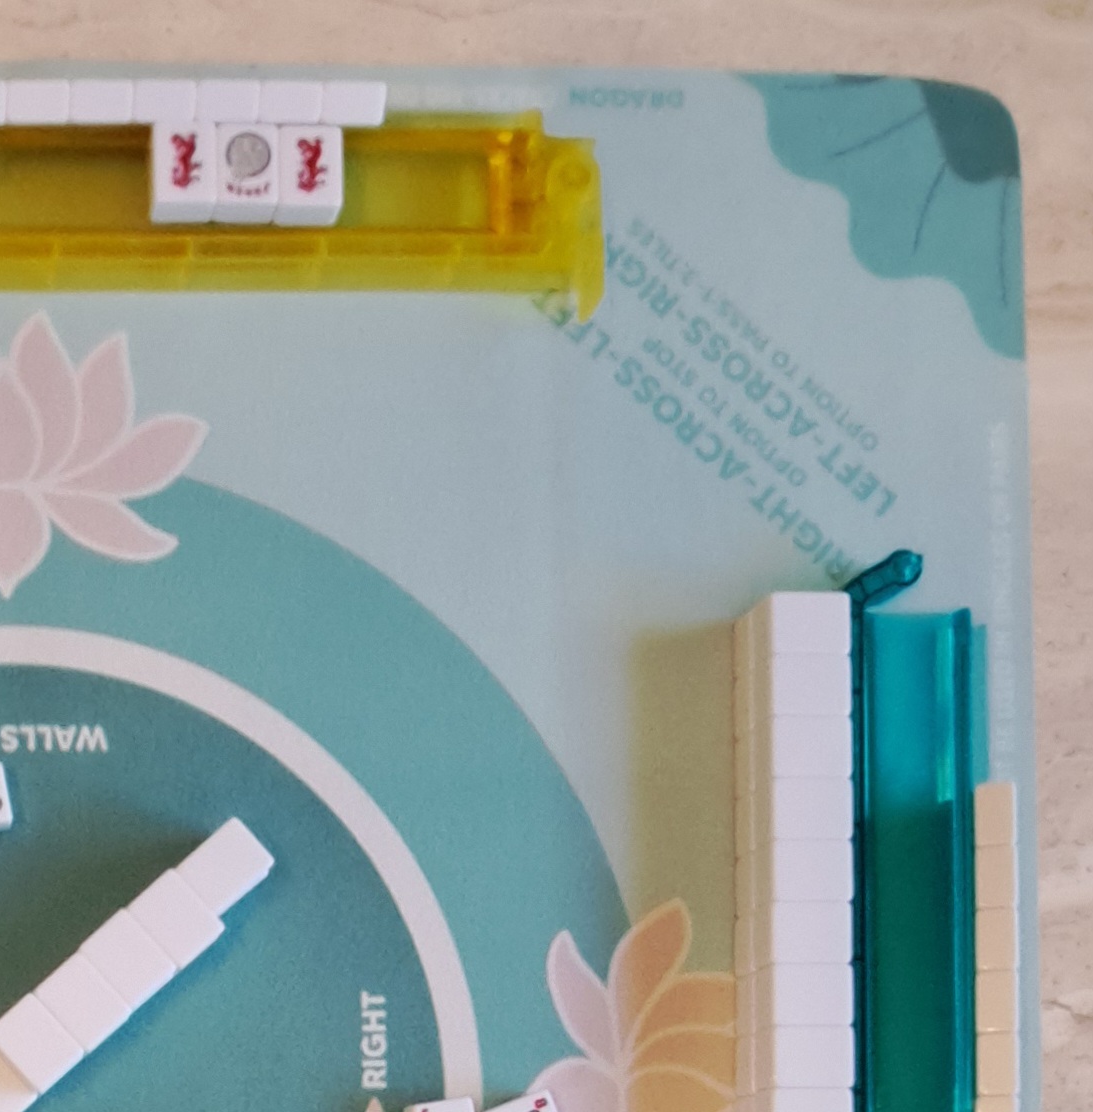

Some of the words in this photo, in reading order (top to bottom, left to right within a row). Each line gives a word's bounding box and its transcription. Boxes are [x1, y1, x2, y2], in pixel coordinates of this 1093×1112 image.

[571, 86, 682, 108] DRAGON
[606, 234, 896, 517] LEFT-ACROSS-RIGH
[641, 334, 698, 387] STOP
[769, 348, 798, 377] TO
[697, 385, 728, 416] TO
[798, 377, 878, 452] OPTION
[728, 414, 806, 487] OPTION
[0, 724, 108, 753] WALLS
[361, 990, 388, 1090] RIGHT
[534, 1098, 547, 1110] 8
